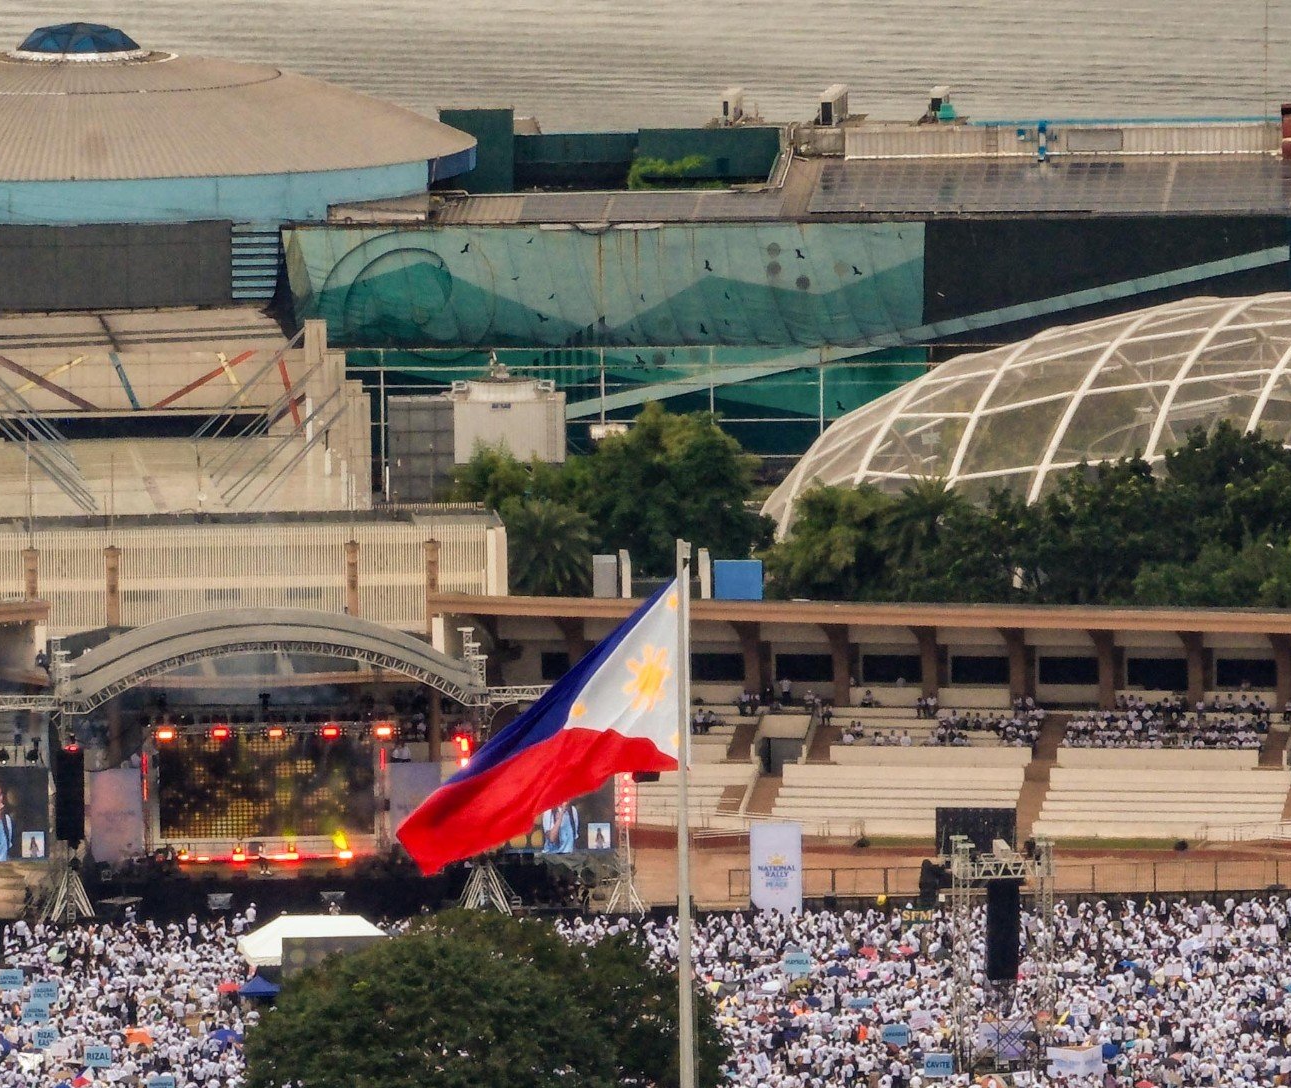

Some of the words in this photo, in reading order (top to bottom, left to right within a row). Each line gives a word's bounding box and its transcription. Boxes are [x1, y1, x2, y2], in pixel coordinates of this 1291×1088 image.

[902, 910, 932, 921] SFM
[37, 1031, 54, 1039] RIZAL
[87, 1052, 110, 1061] RIZAL
[926, 1061, 950, 1069] CAVITE
